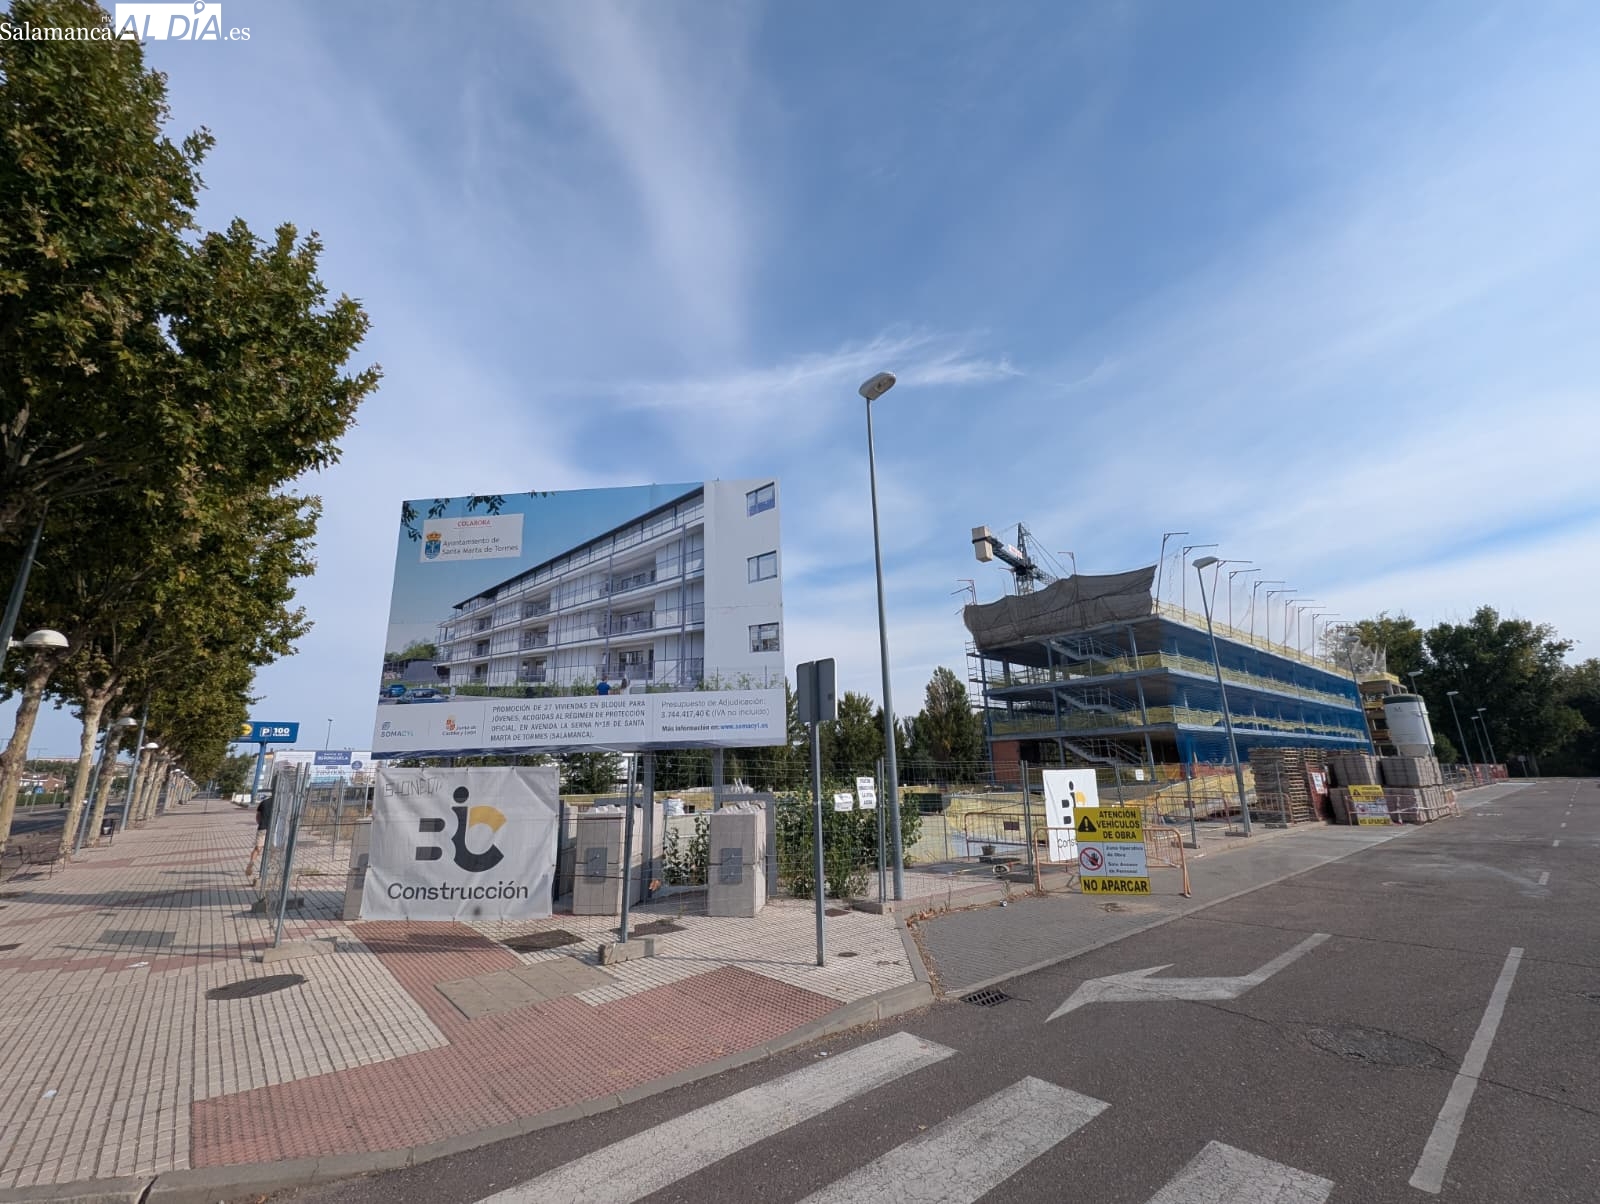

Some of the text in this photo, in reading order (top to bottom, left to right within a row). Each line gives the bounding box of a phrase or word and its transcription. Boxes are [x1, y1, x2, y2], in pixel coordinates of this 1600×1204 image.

[443, 537, 489, 547] Ayuntamiento
[442, 547, 461, 555] Santa
[463, 546, 482, 554] Marta
[495, 544, 519, 553] Tormes
[492, 704, 531, 713] PROMOCIÓN
[555, 703, 588, 711] VIVIENDAS
[601, 701, 626, 709] BLOQUE
[661, 700, 706, 708] Presupuesto
[523, 713, 554, 721] ACOGIDAS
[605, 709, 645, 718] PROTECCIÓN
[711, 709, 726, 718] (IVA
[531, 723, 558, 731] AVENIDA
[571, 721, 592, 729] SERNA
[624, 719, 645, 727] SANTA
[675, 723, 709, 732] información
[490, 734, 512, 742] MARTA
[1099, 809, 1136, 818] ATENCIÓN
[1096, 819, 1140, 829] VEHÍCULOS
[1103, 830, 1136, 839] DE OBRA
[387, 881, 529, 900] Construcción
[1083, 879, 1148, 892] NO APARCAR
